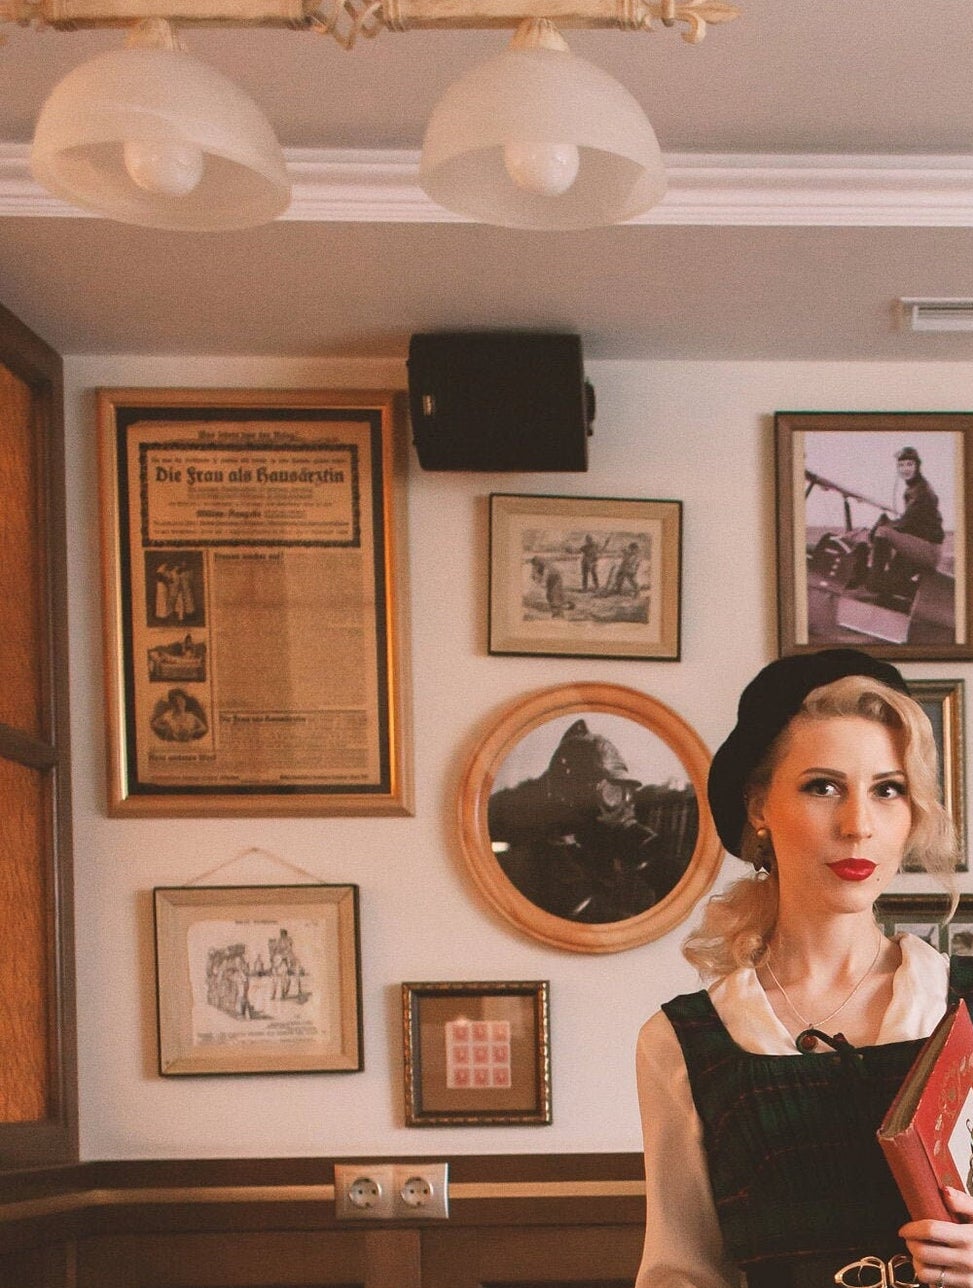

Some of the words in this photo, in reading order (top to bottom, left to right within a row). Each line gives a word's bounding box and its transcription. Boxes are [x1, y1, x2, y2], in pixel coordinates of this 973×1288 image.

[155, 466, 182, 483] Die
[186, 466, 224, 486] Frau
[228, 466, 251, 483] als
